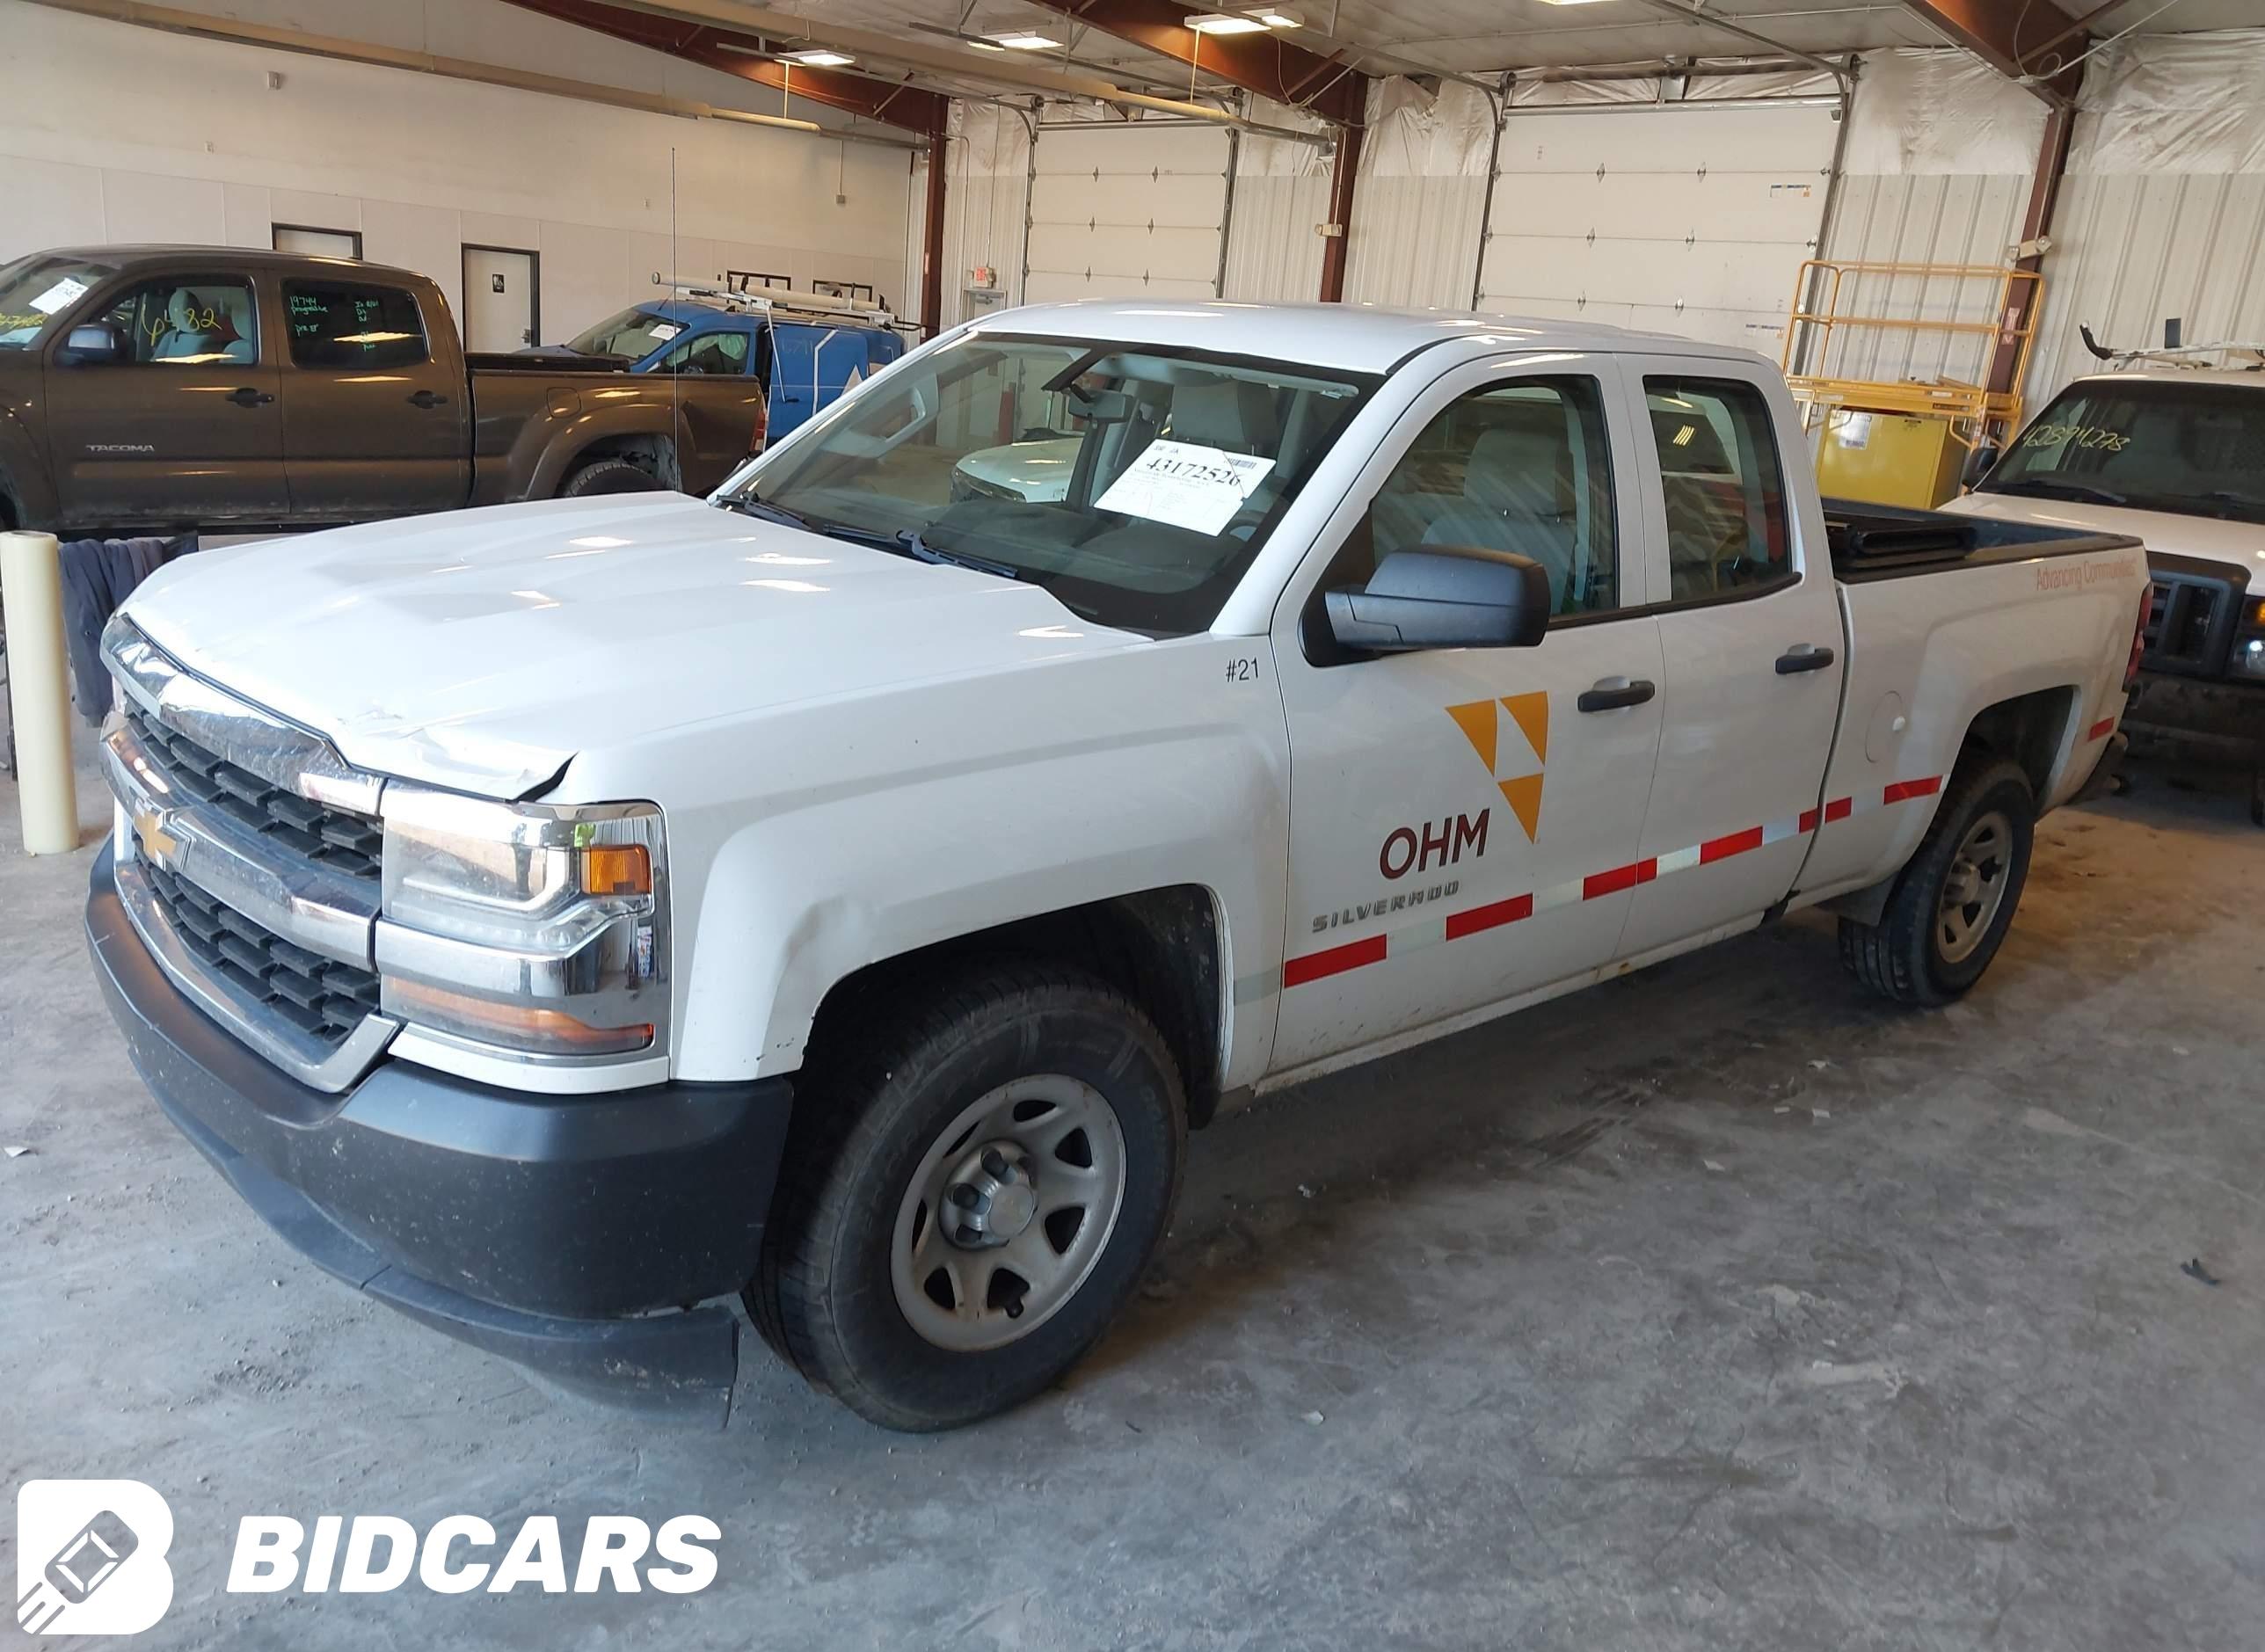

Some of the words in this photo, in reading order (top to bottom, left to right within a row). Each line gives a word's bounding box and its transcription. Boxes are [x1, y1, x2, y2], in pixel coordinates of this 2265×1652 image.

[1146, 457, 1245, 487] 43172526
[2036, 567, 2082, 591] Advancing
[1226, 657, 1258, 683] #21
[1380, 807, 1490, 880] OHM
[1312, 880, 1460, 934] SILVERADO
